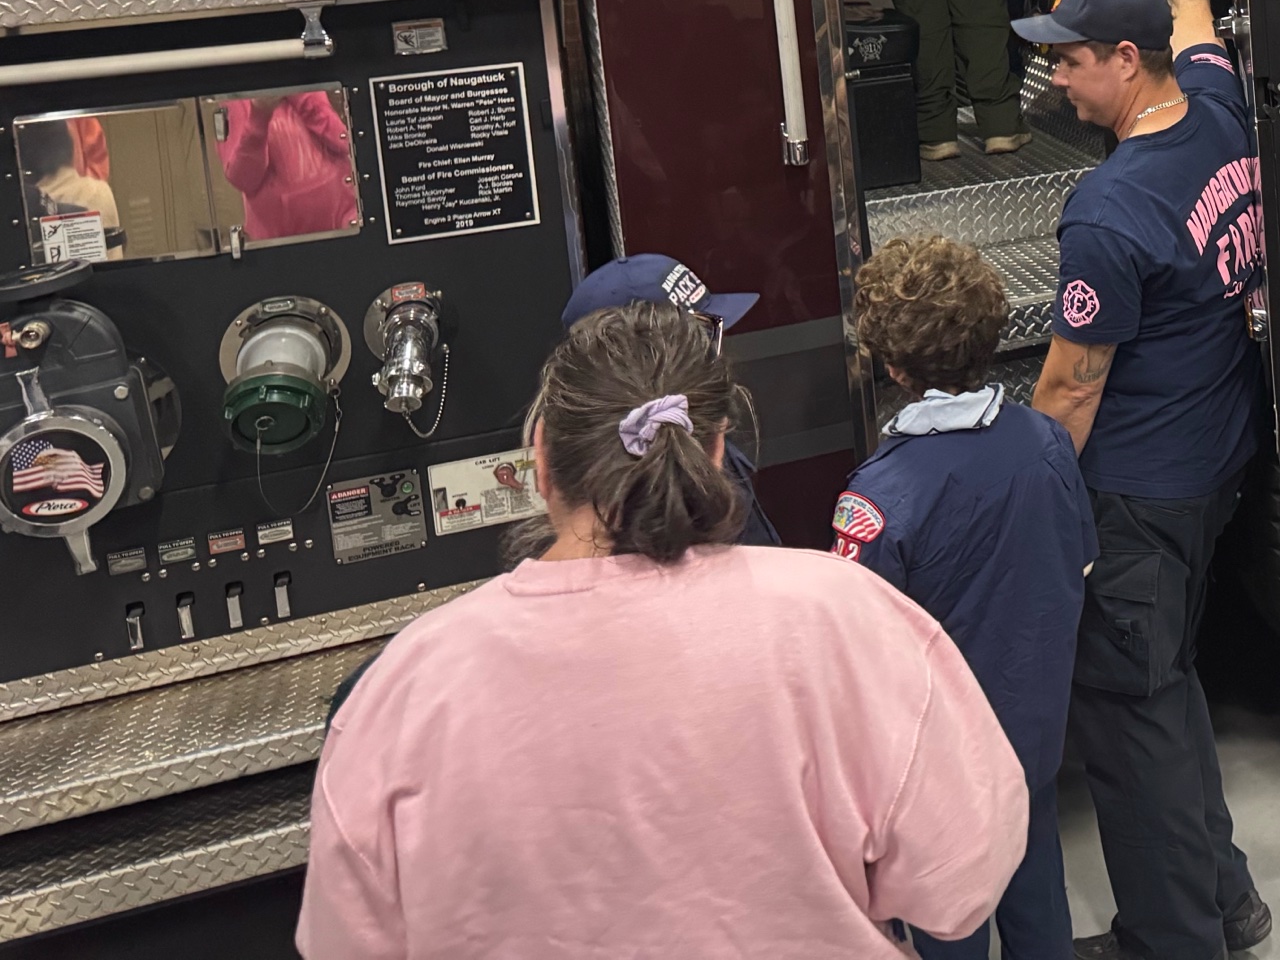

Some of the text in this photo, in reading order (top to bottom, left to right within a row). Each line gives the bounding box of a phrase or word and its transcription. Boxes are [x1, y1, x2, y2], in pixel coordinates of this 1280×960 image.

[388, 72, 506, 93] Borough of Naugatuck
[388, 87, 509, 106] Board of Mayor and Burgesses
[384, 108, 419, 117] Honorable
[420, 105, 441, 113] Mayor
[450, 101, 475, 109] Warren
[497, 96, 515, 104] Hess
[468, 108, 490, 117] Robert
[386, 125, 408, 134] Robert
[470, 124, 494, 132] Dorothy
[470, 131, 490, 139] Rocky
[389, 141, 404, 149] Jack
[426, 144, 449, 153] Donald
[418, 161, 432, 169] Fire
[453, 156, 471, 164] Ellen
[471, 153, 495, 162] Murray
[401, 164, 514, 184] Board of Fire Commissioners
[477, 175, 500, 183] Joseph
[394, 186, 410, 194] John
[493, 186, 513, 194] Martin
[396, 192, 421, 200] Thomas
[396, 198, 426, 207] Raymond
[421, 203, 441, 211] Henry
[424, 217, 447, 225] Engine
[455, 219, 474, 228] 2019
[669, 274, 697, 306] PACK
[337, 487, 367, 498] DANGER
[35, 501, 77, 514] Pierce
[362, 540, 400, 553] POWERED
[348, 543, 416, 562] EQUIPMENT RACK
